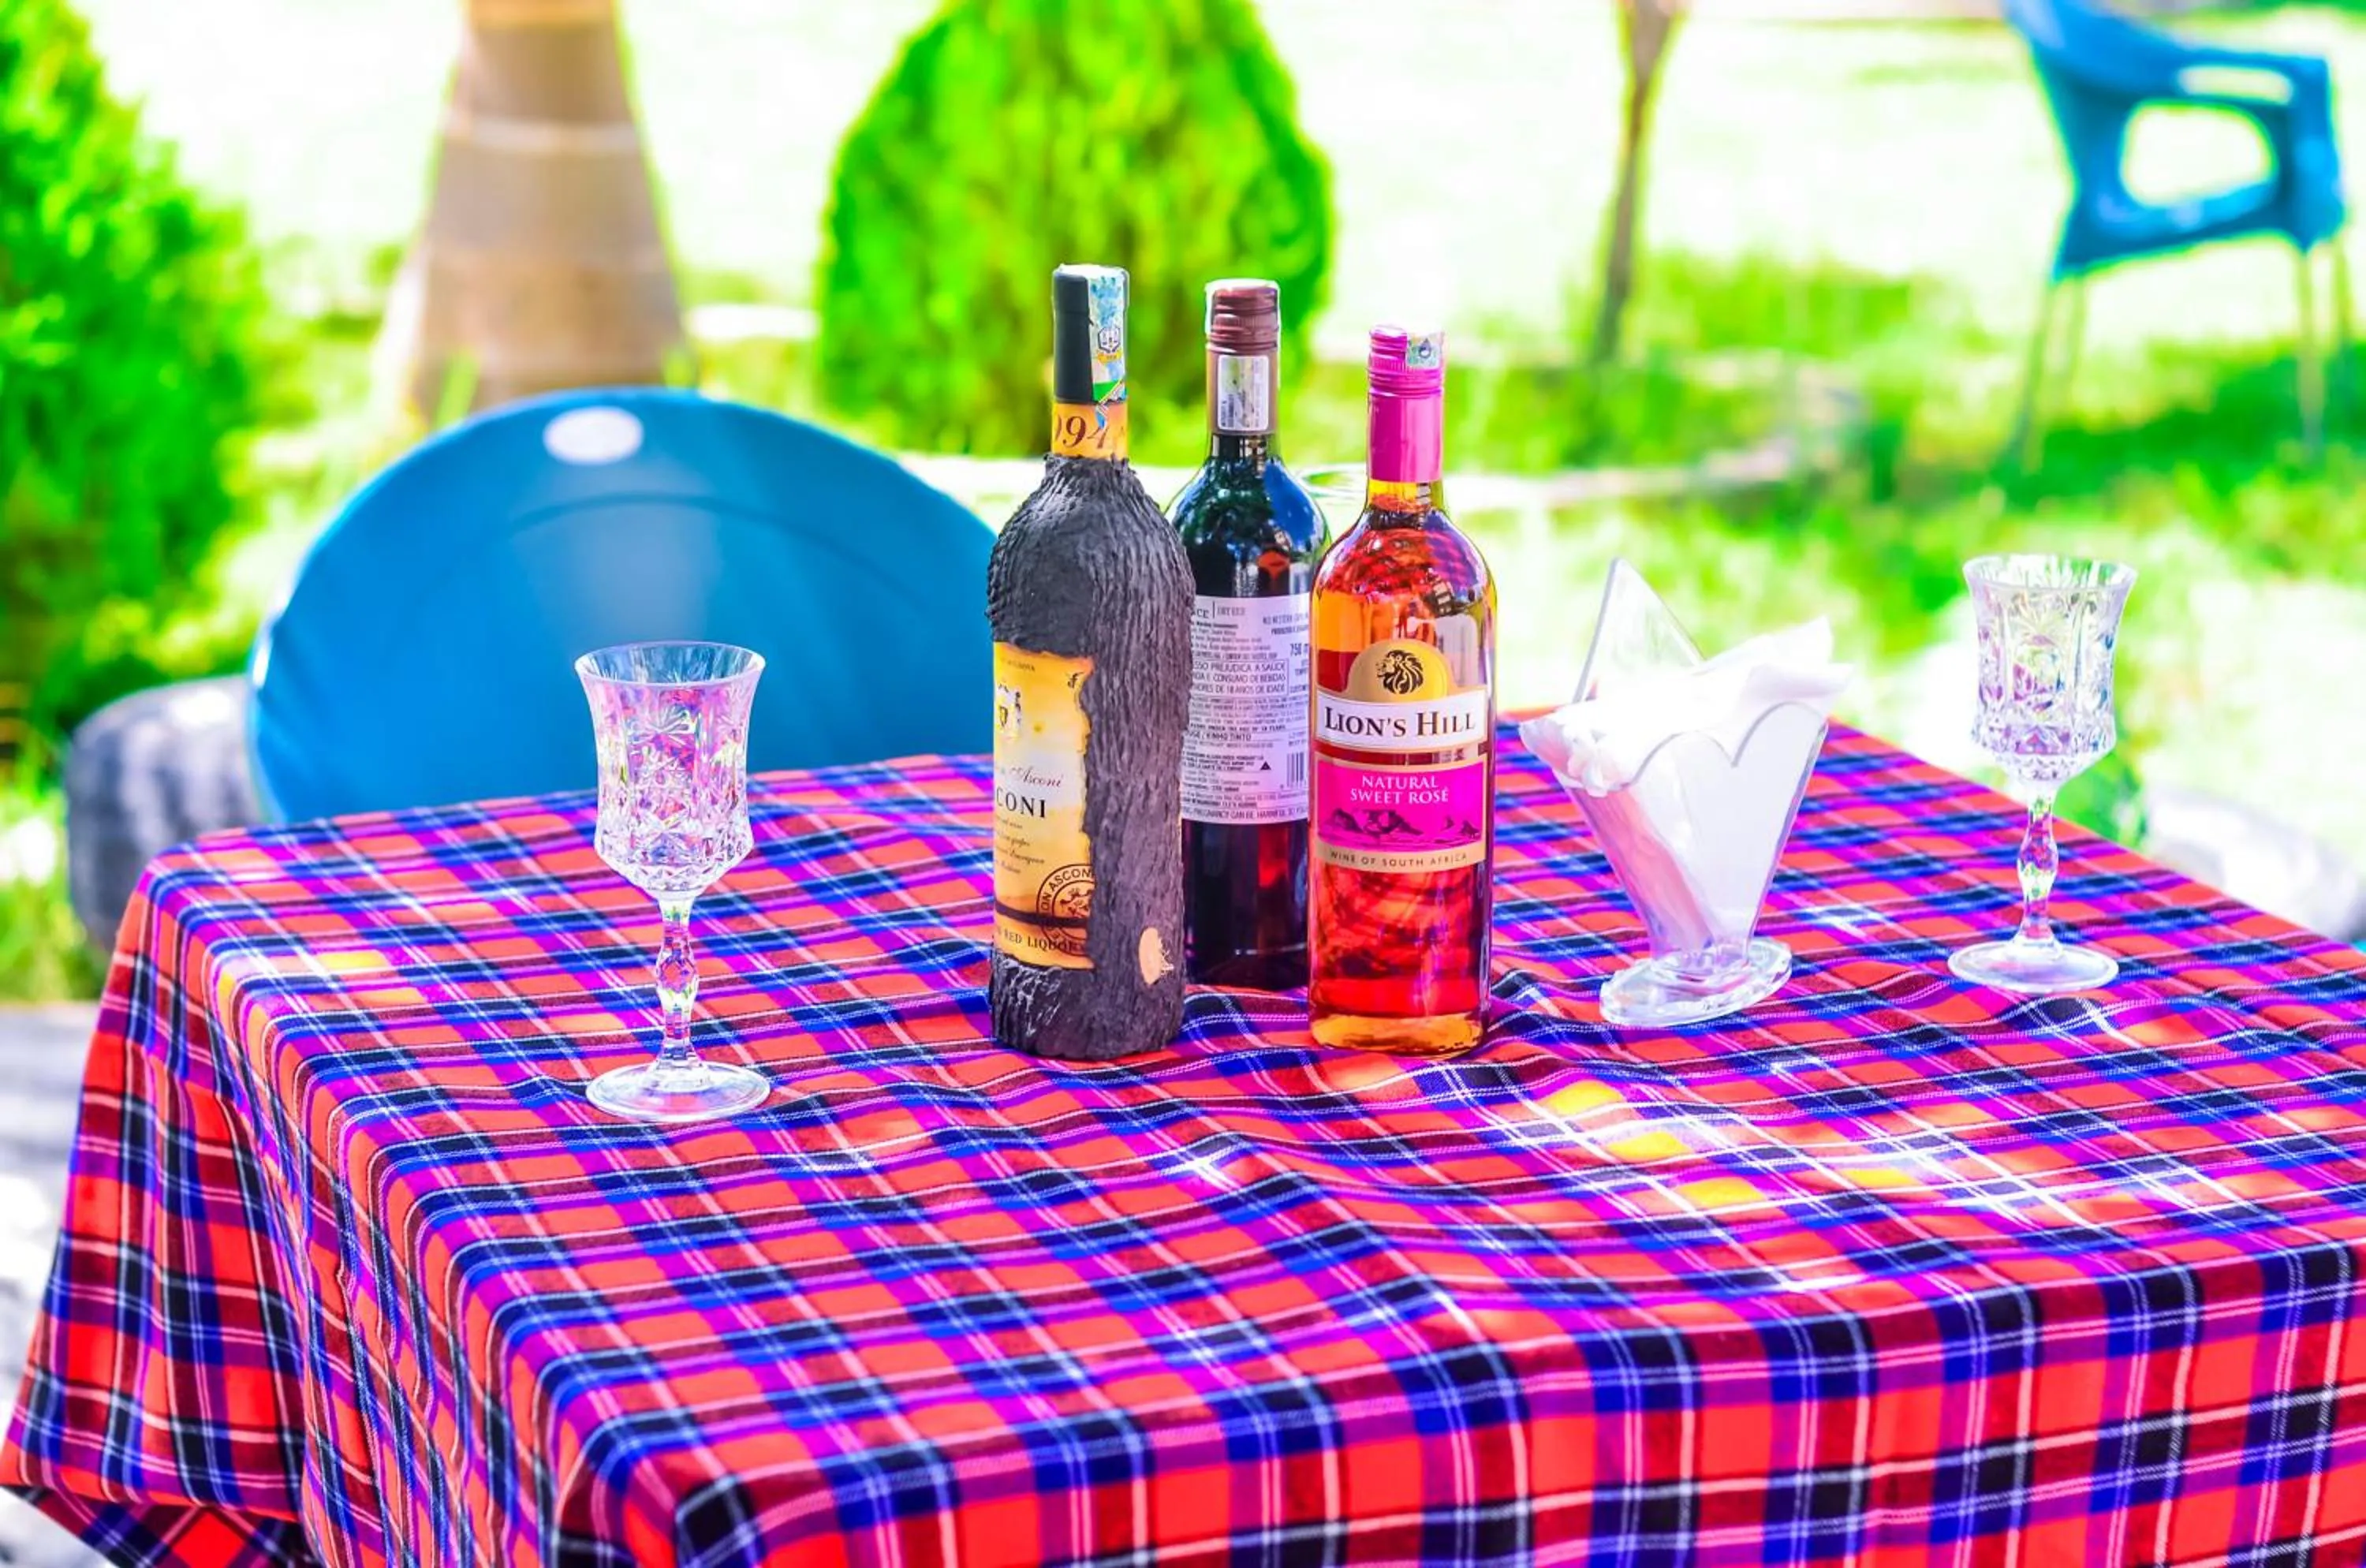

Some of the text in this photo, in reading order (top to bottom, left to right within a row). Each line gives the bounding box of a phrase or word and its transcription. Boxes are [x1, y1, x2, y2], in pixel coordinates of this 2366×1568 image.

[1211, 662, 1252, 672] PREJUDICA
[1213, 674, 1248, 683] CONSUMO
[1260, 673, 1287, 681] BEBIDAS
[1215, 685, 1224, 694] DE
[1267, 684, 1286, 694] IDADE
[1325, 706, 1476, 737] LION'S HILL
[1362, 775, 1439, 789] NATURAL
[1350, 786, 1449, 804] SWEET ROSÉ
[1330, 850, 1468, 868] WINE OF SOUTH AFRICA
